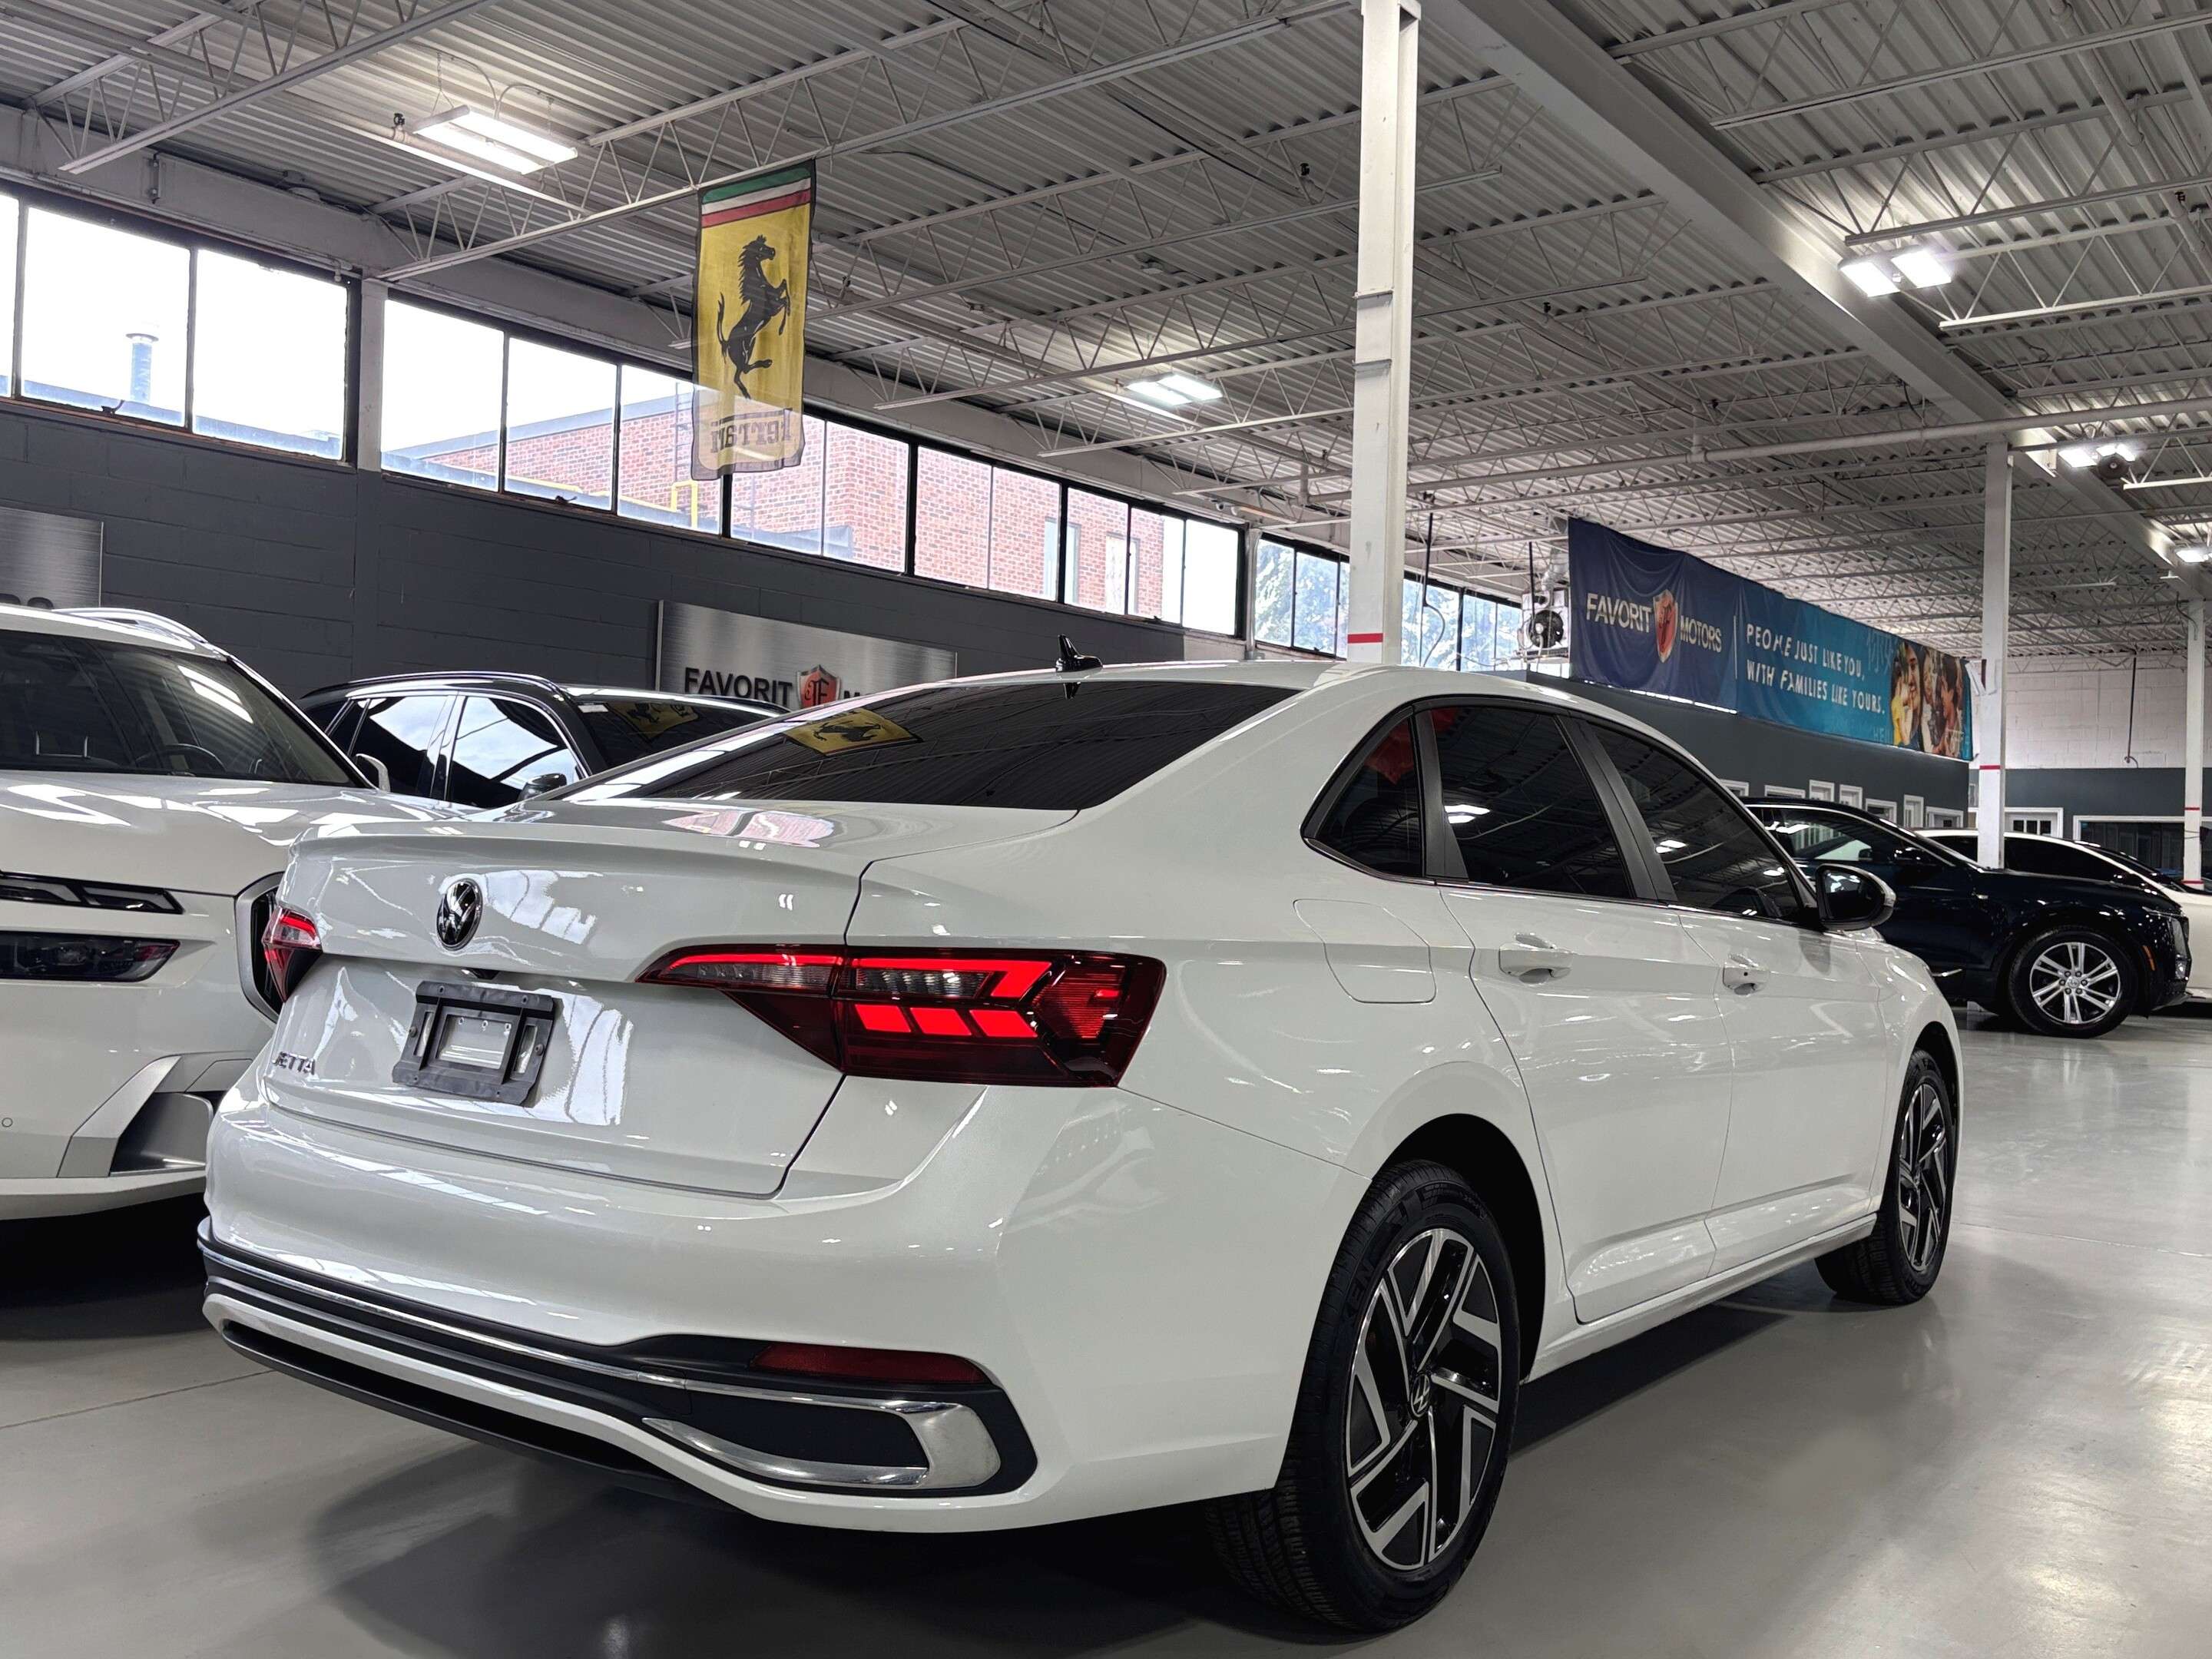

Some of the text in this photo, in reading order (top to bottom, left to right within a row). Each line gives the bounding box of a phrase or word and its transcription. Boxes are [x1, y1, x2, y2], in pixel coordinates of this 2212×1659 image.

[1586, 593, 1651, 633] FAVORIT
[1680, 615, 1722, 653] MOTORS
[1794, 640, 1818, 664] JUST
[1823, 648, 1842, 671] LIKE
[1844, 656, 1865, 680] YOU,
[684, 667, 793, 706] FAVORIT
[1747, 659, 1886, 714] WITH FAMILIES LIKE YOURS.
[272, 1051, 316, 1075] JETTA
